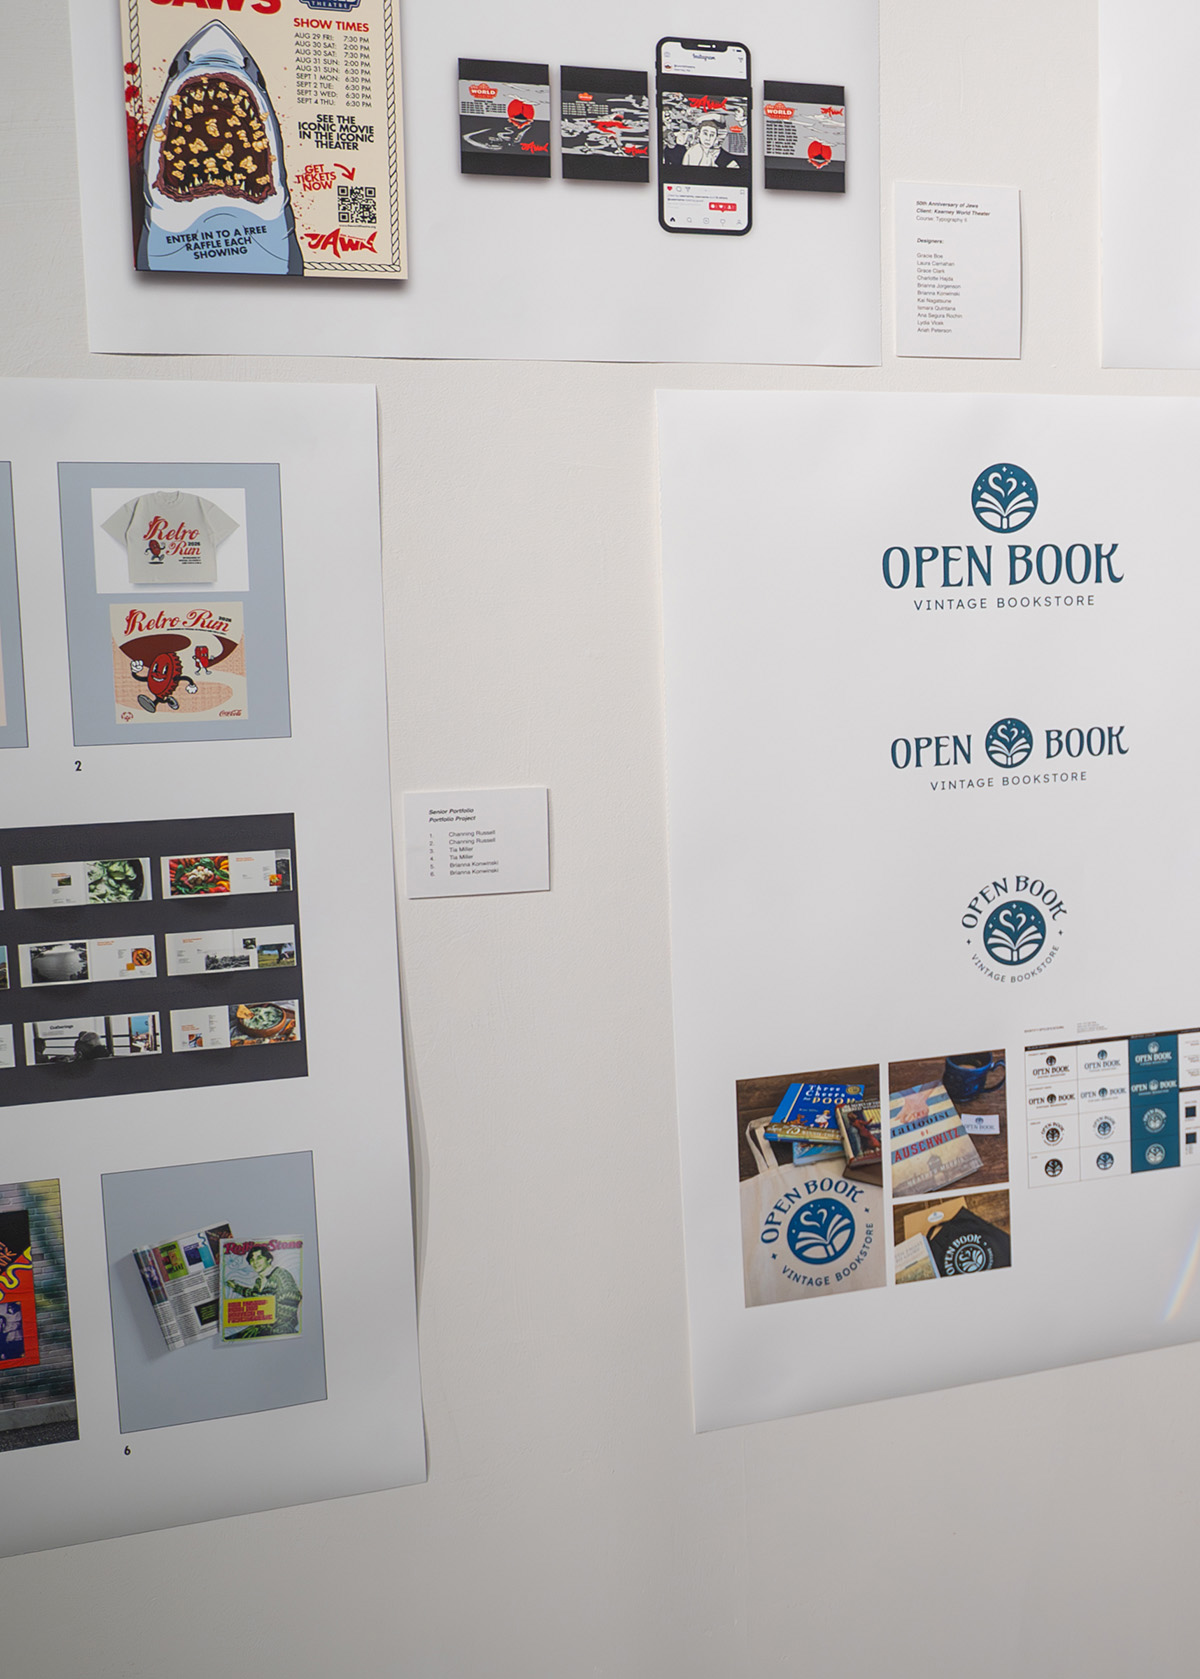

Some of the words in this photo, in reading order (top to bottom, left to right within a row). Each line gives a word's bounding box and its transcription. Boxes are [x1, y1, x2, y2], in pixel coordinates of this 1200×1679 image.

[294, 18, 332, 29] SHOW
[336, 21, 369, 32] TIMES
[316, 114, 335, 123] SEE
[337, 115, 355, 124] THE
[298, 122, 336, 132] ICONIC
[340, 125, 374, 134] MOVIE
[300, 131, 311, 140] IN
[314, 132, 333, 141] THE
[337, 133, 374, 143] ICONIC
[315, 140, 359, 150] THEATER
[305, 164, 324, 173] GET
[295, 172, 337, 183] TICKETS
[303, 181, 333, 192] NOW
[166, 233, 198, 244] ENTER
[201, 231, 213, 240] IN
[216, 230, 230, 238] TO
[244, 226, 267, 235] FREE
[186, 241, 221, 251] RAFFLE
[225, 237, 252, 246] EACH
[194, 246, 248, 260] SHOWING
[143, 516, 200, 541] Retro
[166, 541, 201, 556] Run
[882, 545, 992, 589] OPEN
[1008, 543, 1125, 585] BOOK
[914, 598, 987, 611] VINTAGE
[997, 595, 1095, 609] BOOKSTORE
[124, 609, 180, 636] Retro
[182, 608, 230, 632] Run
[890, 734, 972, 770] OPEN
[1045, 725, 1130, 759] BOOK
[75, 761, 82, 772] 2
[930, 777, 994, 791] VINTAGE
[1002, 771, 1088, 786] BOOKSTORE
[961, 877, 1009, 929] OPEN
[1015, 875, 1068, 922] BOOK
[971, 953, 1006, 983] VINTAGE
[1010, 944, 1060, 984] BOOKSTORE
[895, 1128, 960, 1163] AUSCHWITZ
[761, 1187, 802, 1244] OPEN
[804, 1177, 864, 1203] BOOK
[952, 1234, 982, 1248] BOOK
[782, 1264, 830, 1287] VINTAGE
[835, 1223, 874, 1282] BOOKSTORE
[124, 1446, 131, 1456] 6
